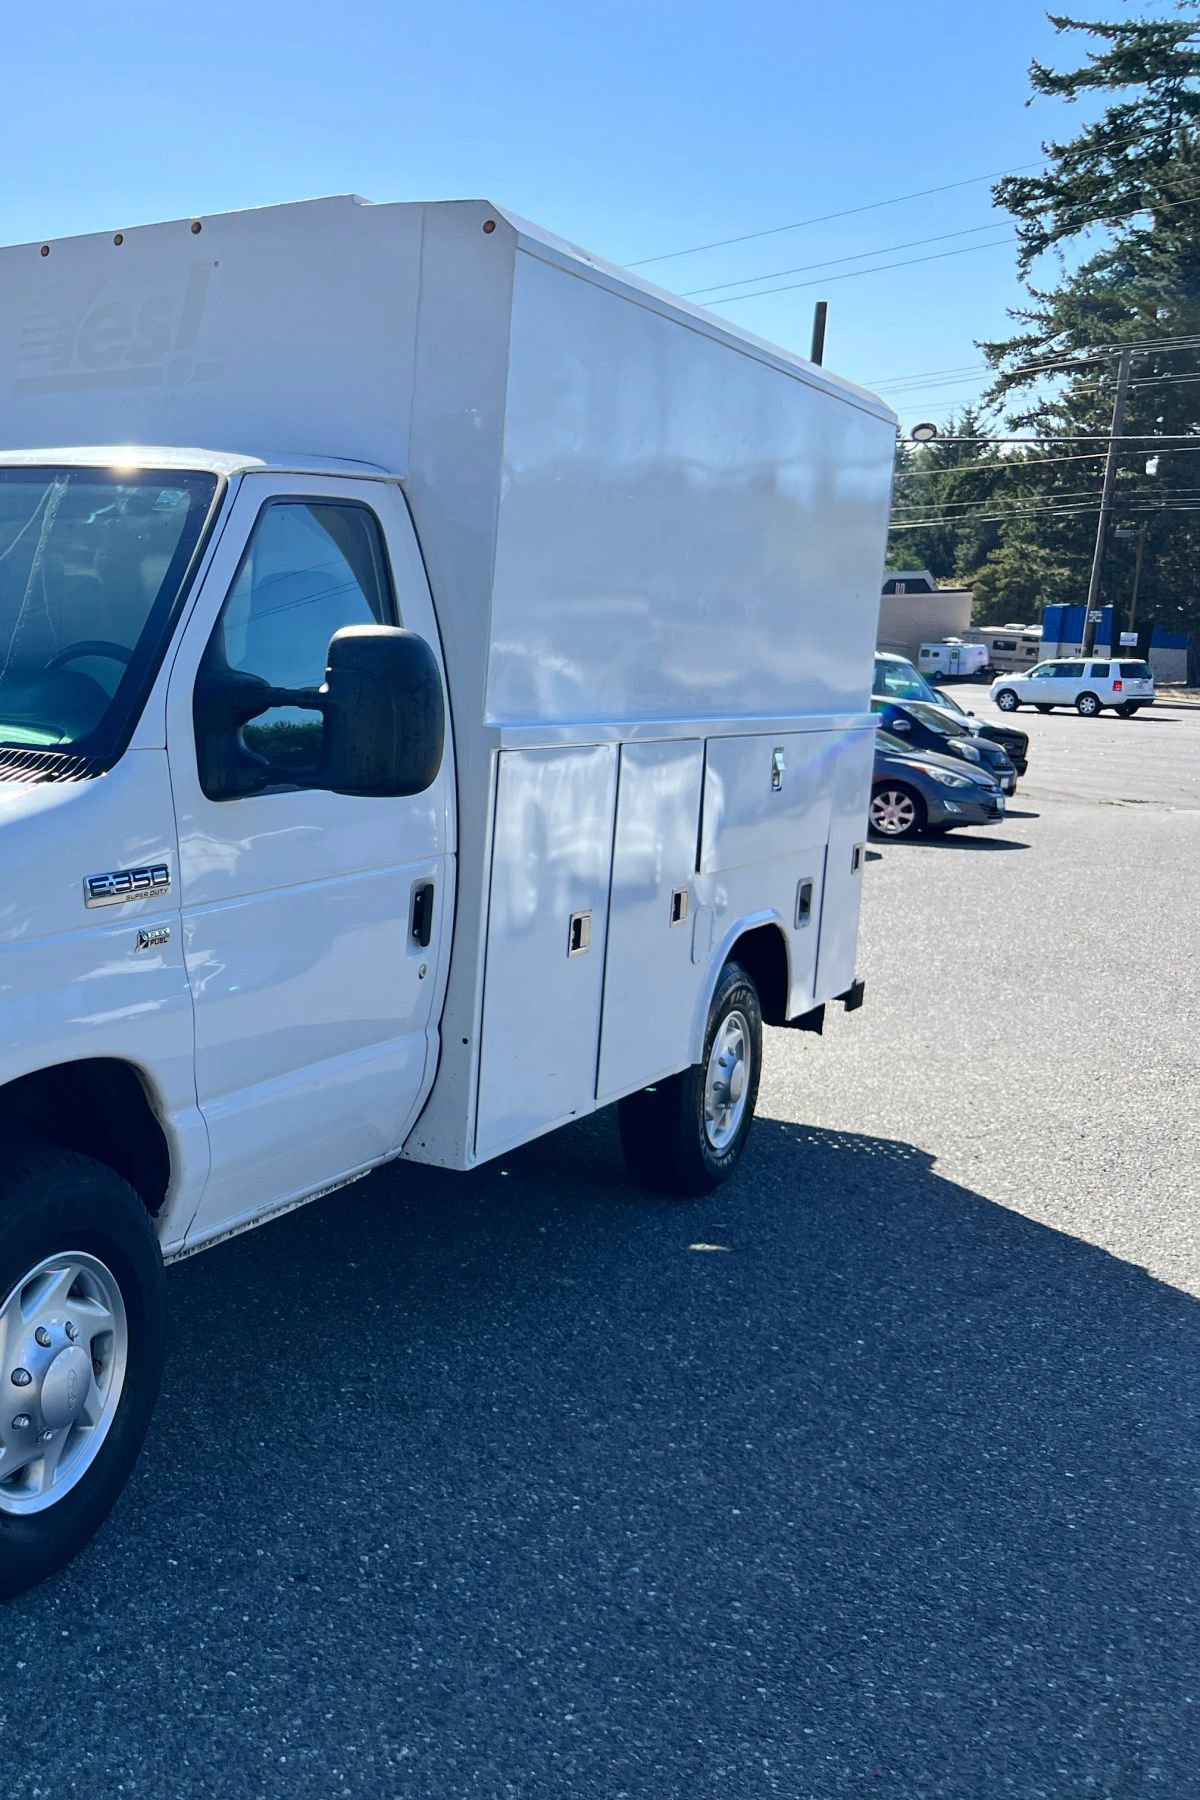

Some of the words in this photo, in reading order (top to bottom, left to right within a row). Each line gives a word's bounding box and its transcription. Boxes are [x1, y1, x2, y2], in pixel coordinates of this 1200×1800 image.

[126, 891, 148, 901] SUPER
[150, 888, 168, 897] DUTY
[150, 937, 168, 947] FUEL
